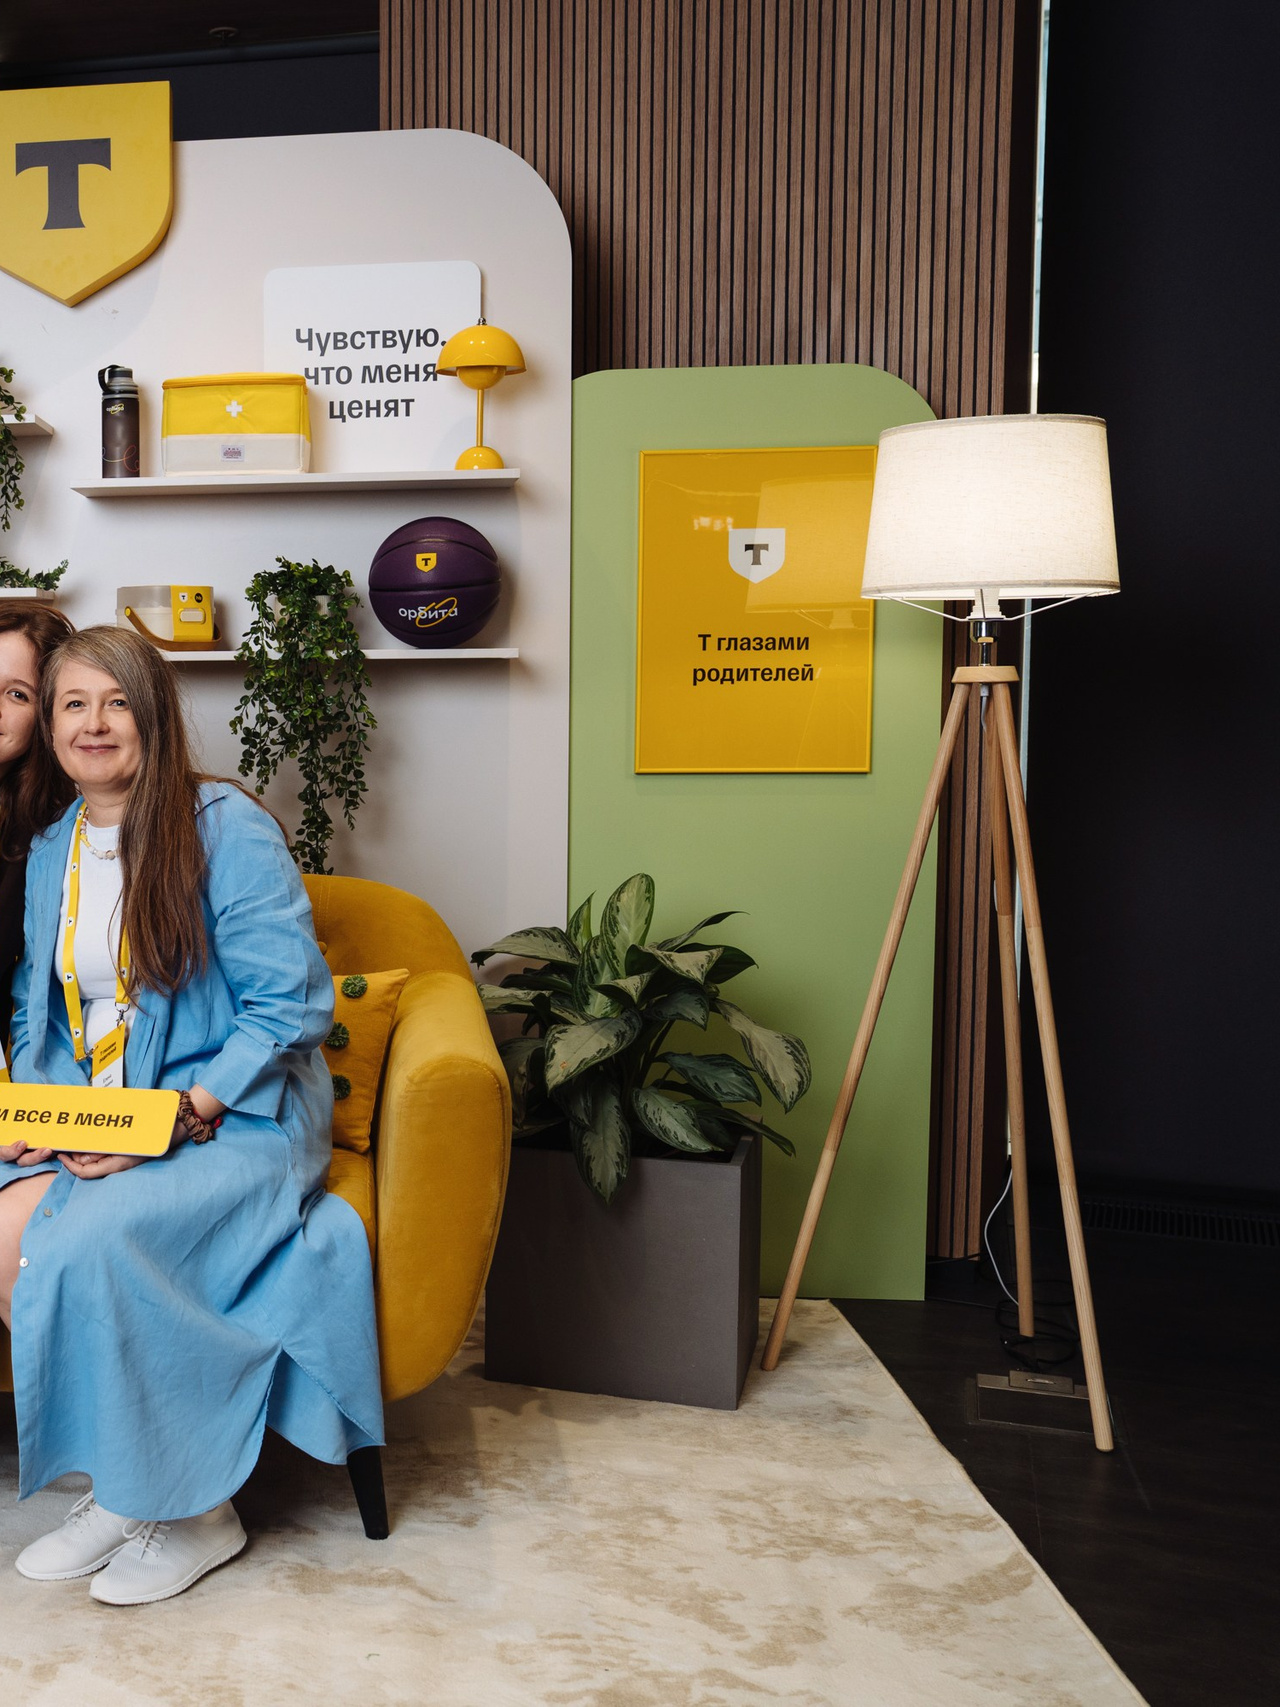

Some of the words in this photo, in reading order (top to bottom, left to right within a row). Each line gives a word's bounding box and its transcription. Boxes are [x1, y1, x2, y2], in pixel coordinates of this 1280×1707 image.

[15, 137, 112, 230] Т
[304, 365, 352, 385] что
[361, 363, 438, 384] меня
[329, 398, 415, 423] ценят
[421, 557, 431, 566] Т
[744, 543, 769, 565] Т
[398, 606, 458, 620] орбита
[698, 634, 711, 651] Т
[717, 634, 810, 651] глазами
[693, 664, 814, 686] родителей
[13, 1108, 52, 1124] все
[57, 1110, 69, 1124] в
[74, 1111, 134, 1129] меня
